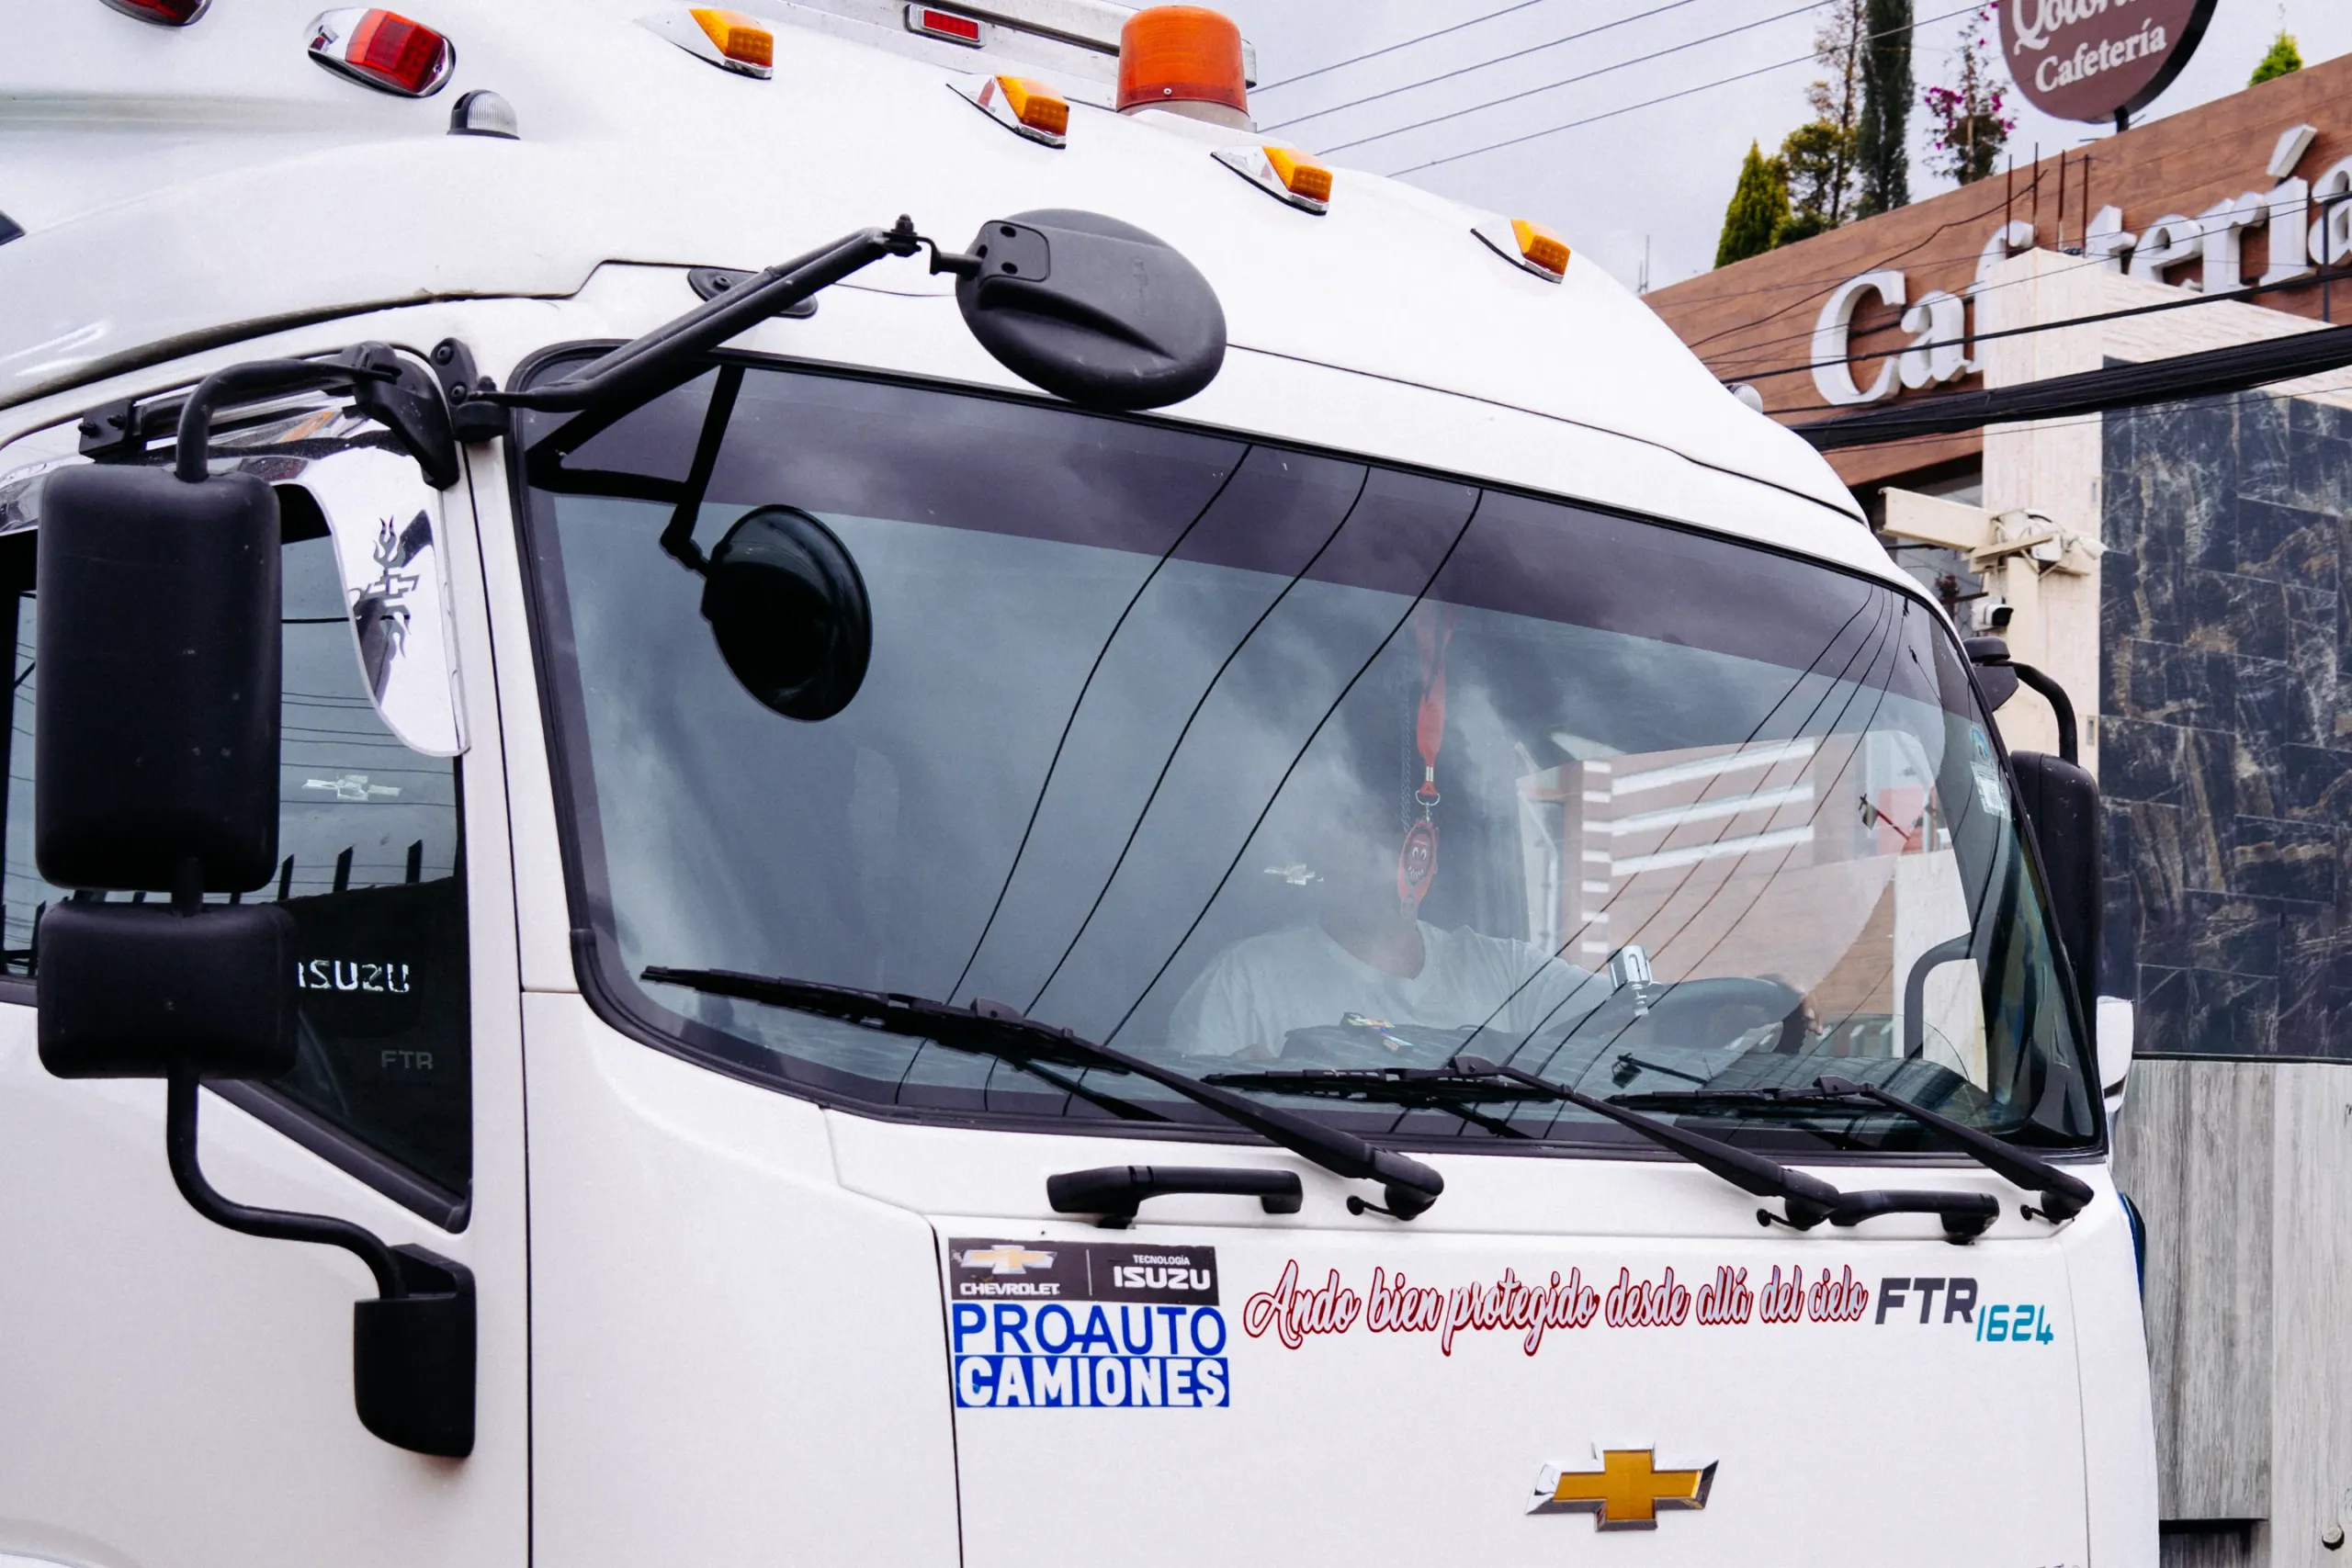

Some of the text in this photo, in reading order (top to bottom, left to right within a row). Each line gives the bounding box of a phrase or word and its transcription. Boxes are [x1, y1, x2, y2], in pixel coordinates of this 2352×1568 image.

[2035, 17, 2167, 93] Cafetería
[1810, 123, 2352, 406] Caftería
[298, 959, 410, 993] ISUZU
[380, 1050, 434, 1070] FTR
[1113, 1266, 1211, 1291] ISUZU
[1133, 1254, 1190, 1266] TECNOLOGÍA
[959, 1282, 1060, 1296] CHEVROLET
[1243, 1258, 1869, 1357] Ando bien protegido desde allá del cielo
[1875, 1278, 2054, 1346] FTR 1624
[958, 1356, 1226, 1407] CAMIONES
